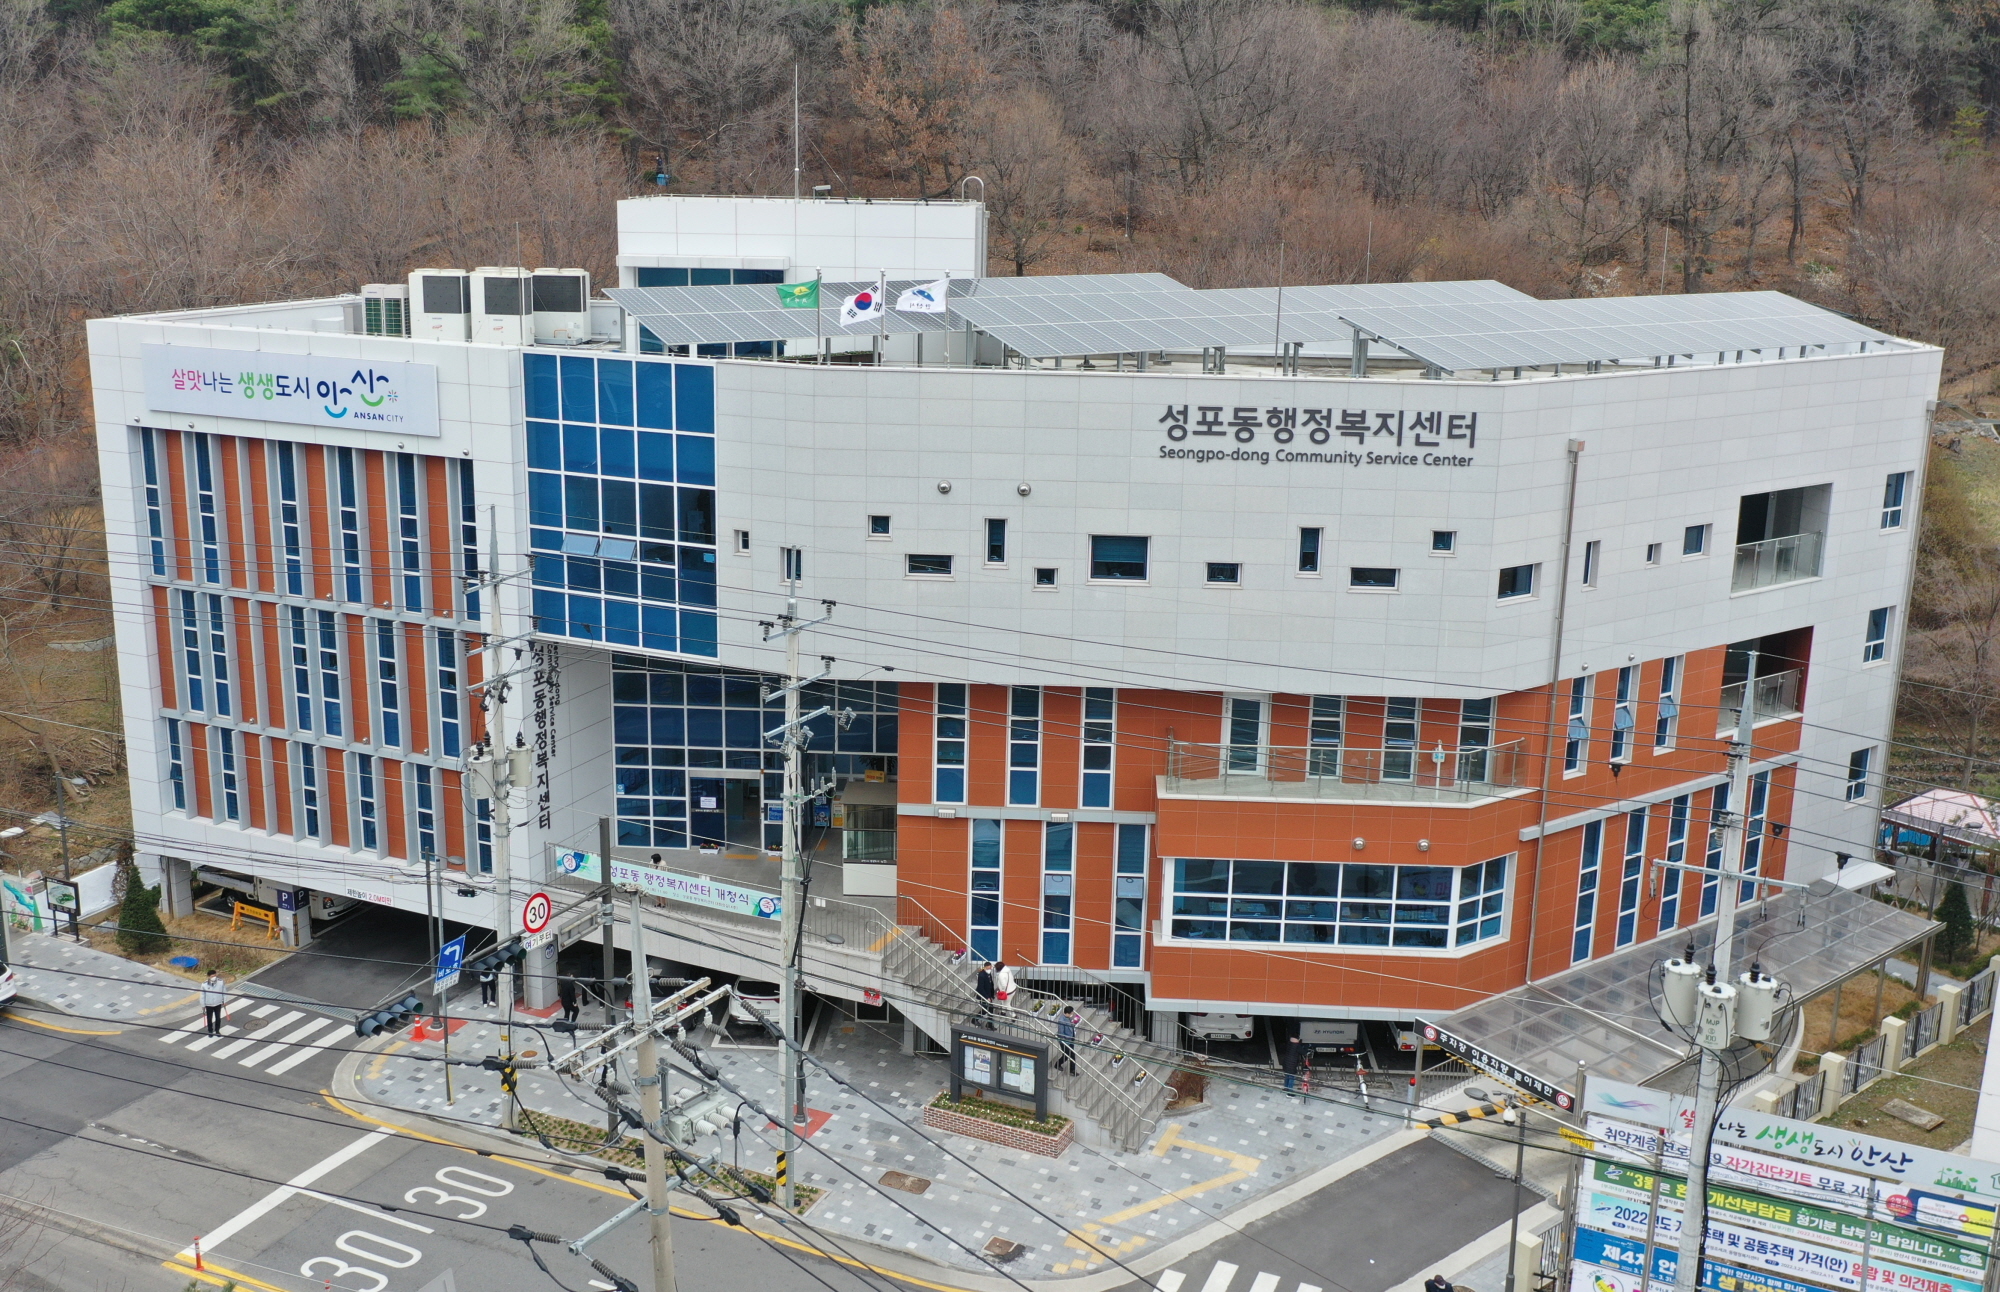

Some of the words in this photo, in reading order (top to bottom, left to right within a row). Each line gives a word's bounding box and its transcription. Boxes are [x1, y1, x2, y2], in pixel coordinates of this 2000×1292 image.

[172, 368, 233, 394] 살맛나는
[238, 371, 311, 400] 생생도시
[353, 411, 385, 422] ANSAN
[386, 413, 404, 423] CITY
[1158, 404, 1478, 450] 성포동행정복지센터
[1159, 446, 1270, 465] Seongpo-dong
[1275, 449, 1363, 468] Community
[1366, 452, 1418, 466] Service
[1423, 453, 1474, 468] Center
[282, 892, 288, 902] P
[298, 890, 305, 901] P
[347, 888, 368, 900] 제한높이
[610, 865, 640, 883] 성포동
[643, 872, 711, 898] 행정복지센터
[714, 887, 749, 906] 개청식
[529, 902, 546, 924] 30
[524, 931, 552, 950] 여기부터
[1706, 1018, 1720, 1026] MJP
[1439, 1032, 1467, 1053] 주차장
[1471, 1049, 1509, 1074] 이용차량
[1513, 1070, 1553, 1097] 높이제한
[1680, 1108, 1747, 1139] 살나는
[1755, 1125, 1843, 1159] 생생도시
[1850, 1144, 1914, 1174] 안산
[1604, 1127, 1658, 1152] 취약계층
[1726, 1155, 1813, 1187] 자가진단키트
[1817, 1177, 1846, 1194] 무료
[404, 1165, 515, 1220] 30
[1796, 1212, 1837, 1233] 정기분
[1841, 1223, 1882, 1244] 납부의
[300, 1229, 423, 1292] 30
[1727, 1232, 1741, 1248] 및
[1743, 1236, 1795, 1261] 공동주택
[1798, 1249, 1848, 1273] 가격(안)
[1881, 1269, 1896, 1285] 및
